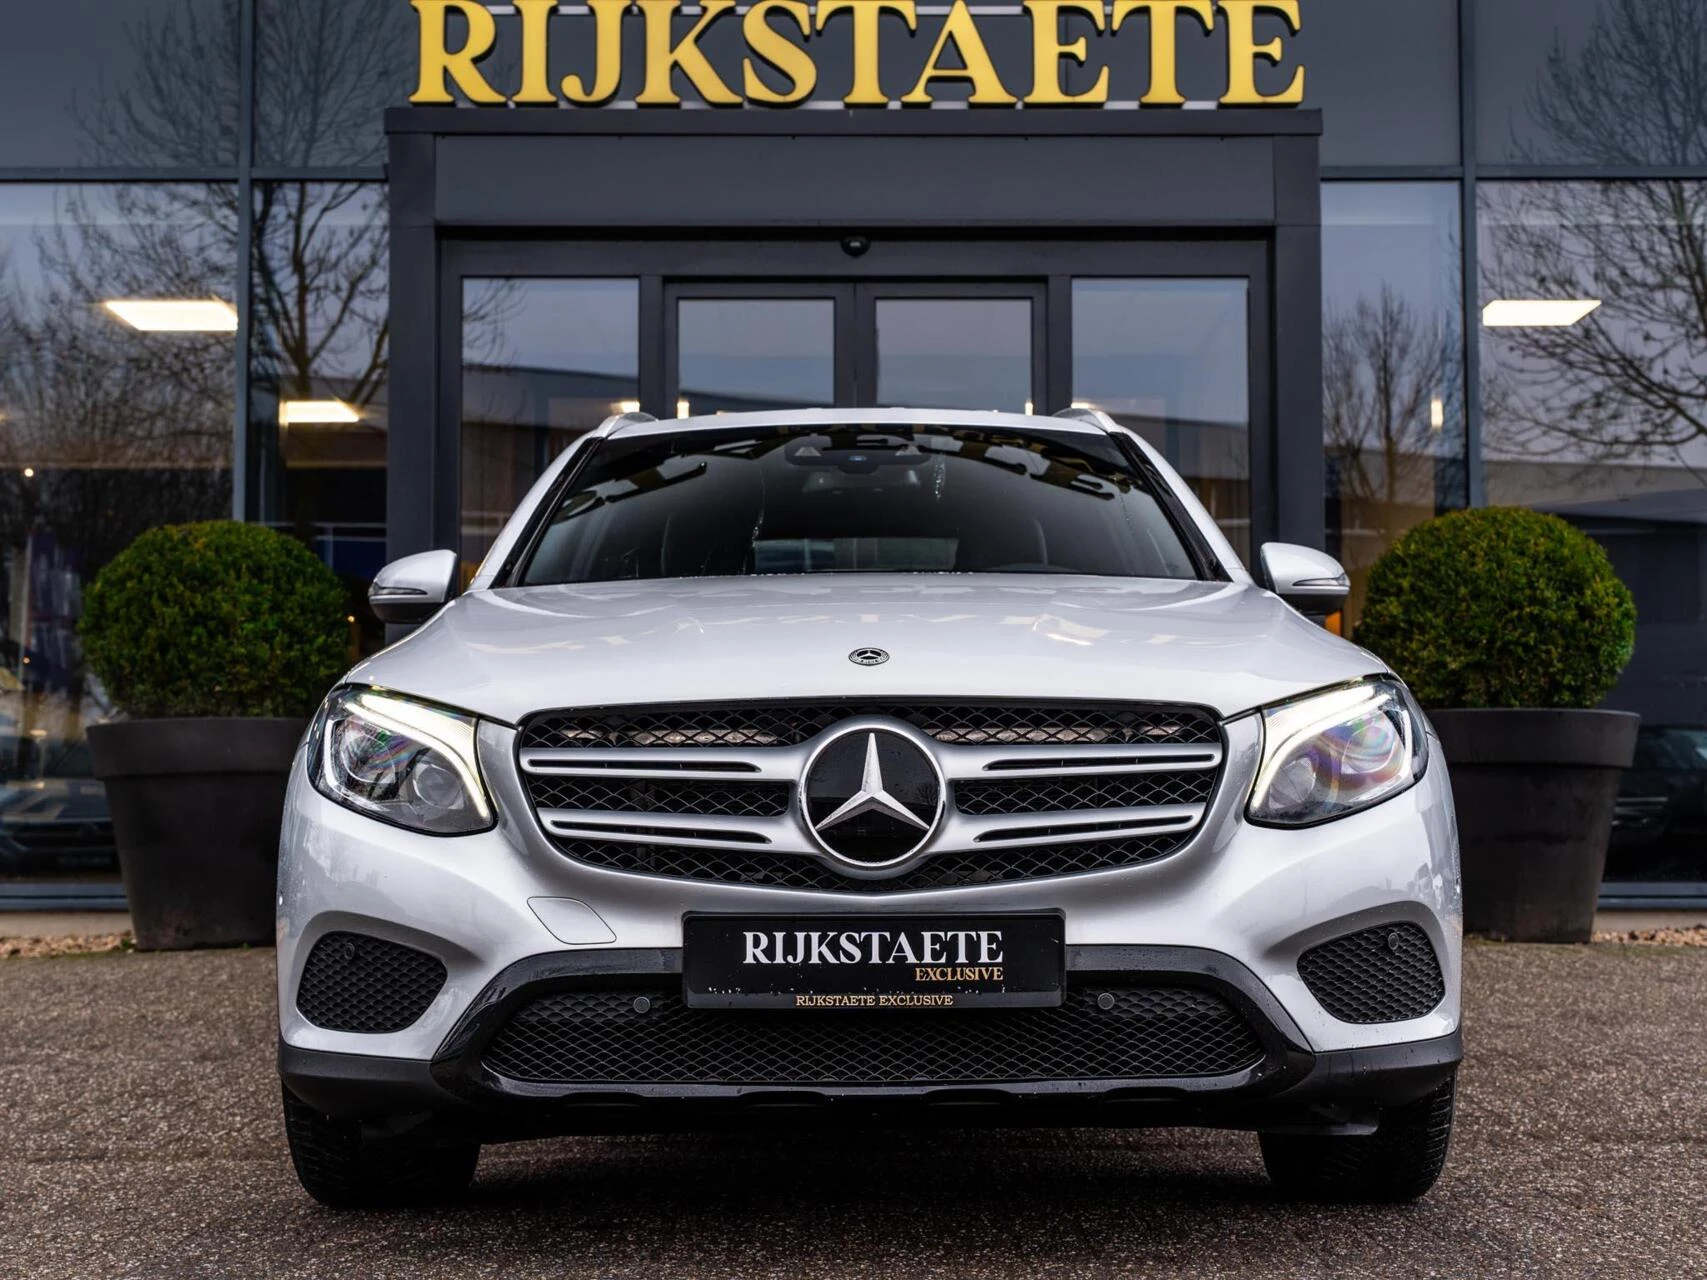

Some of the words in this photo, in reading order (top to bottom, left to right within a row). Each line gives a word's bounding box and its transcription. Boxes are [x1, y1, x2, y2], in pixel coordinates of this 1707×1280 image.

[409, 0, 1305, 105] RIJKSTAETE
[742, 931, 1003, 964] RIJKSTAETE
[915, 967, 1003, 981] EXCLUSIVE
[796, 995, 876, 1006] RIJKSTAETE
[878, 995, 954, 1006] EXCLUSIVE
